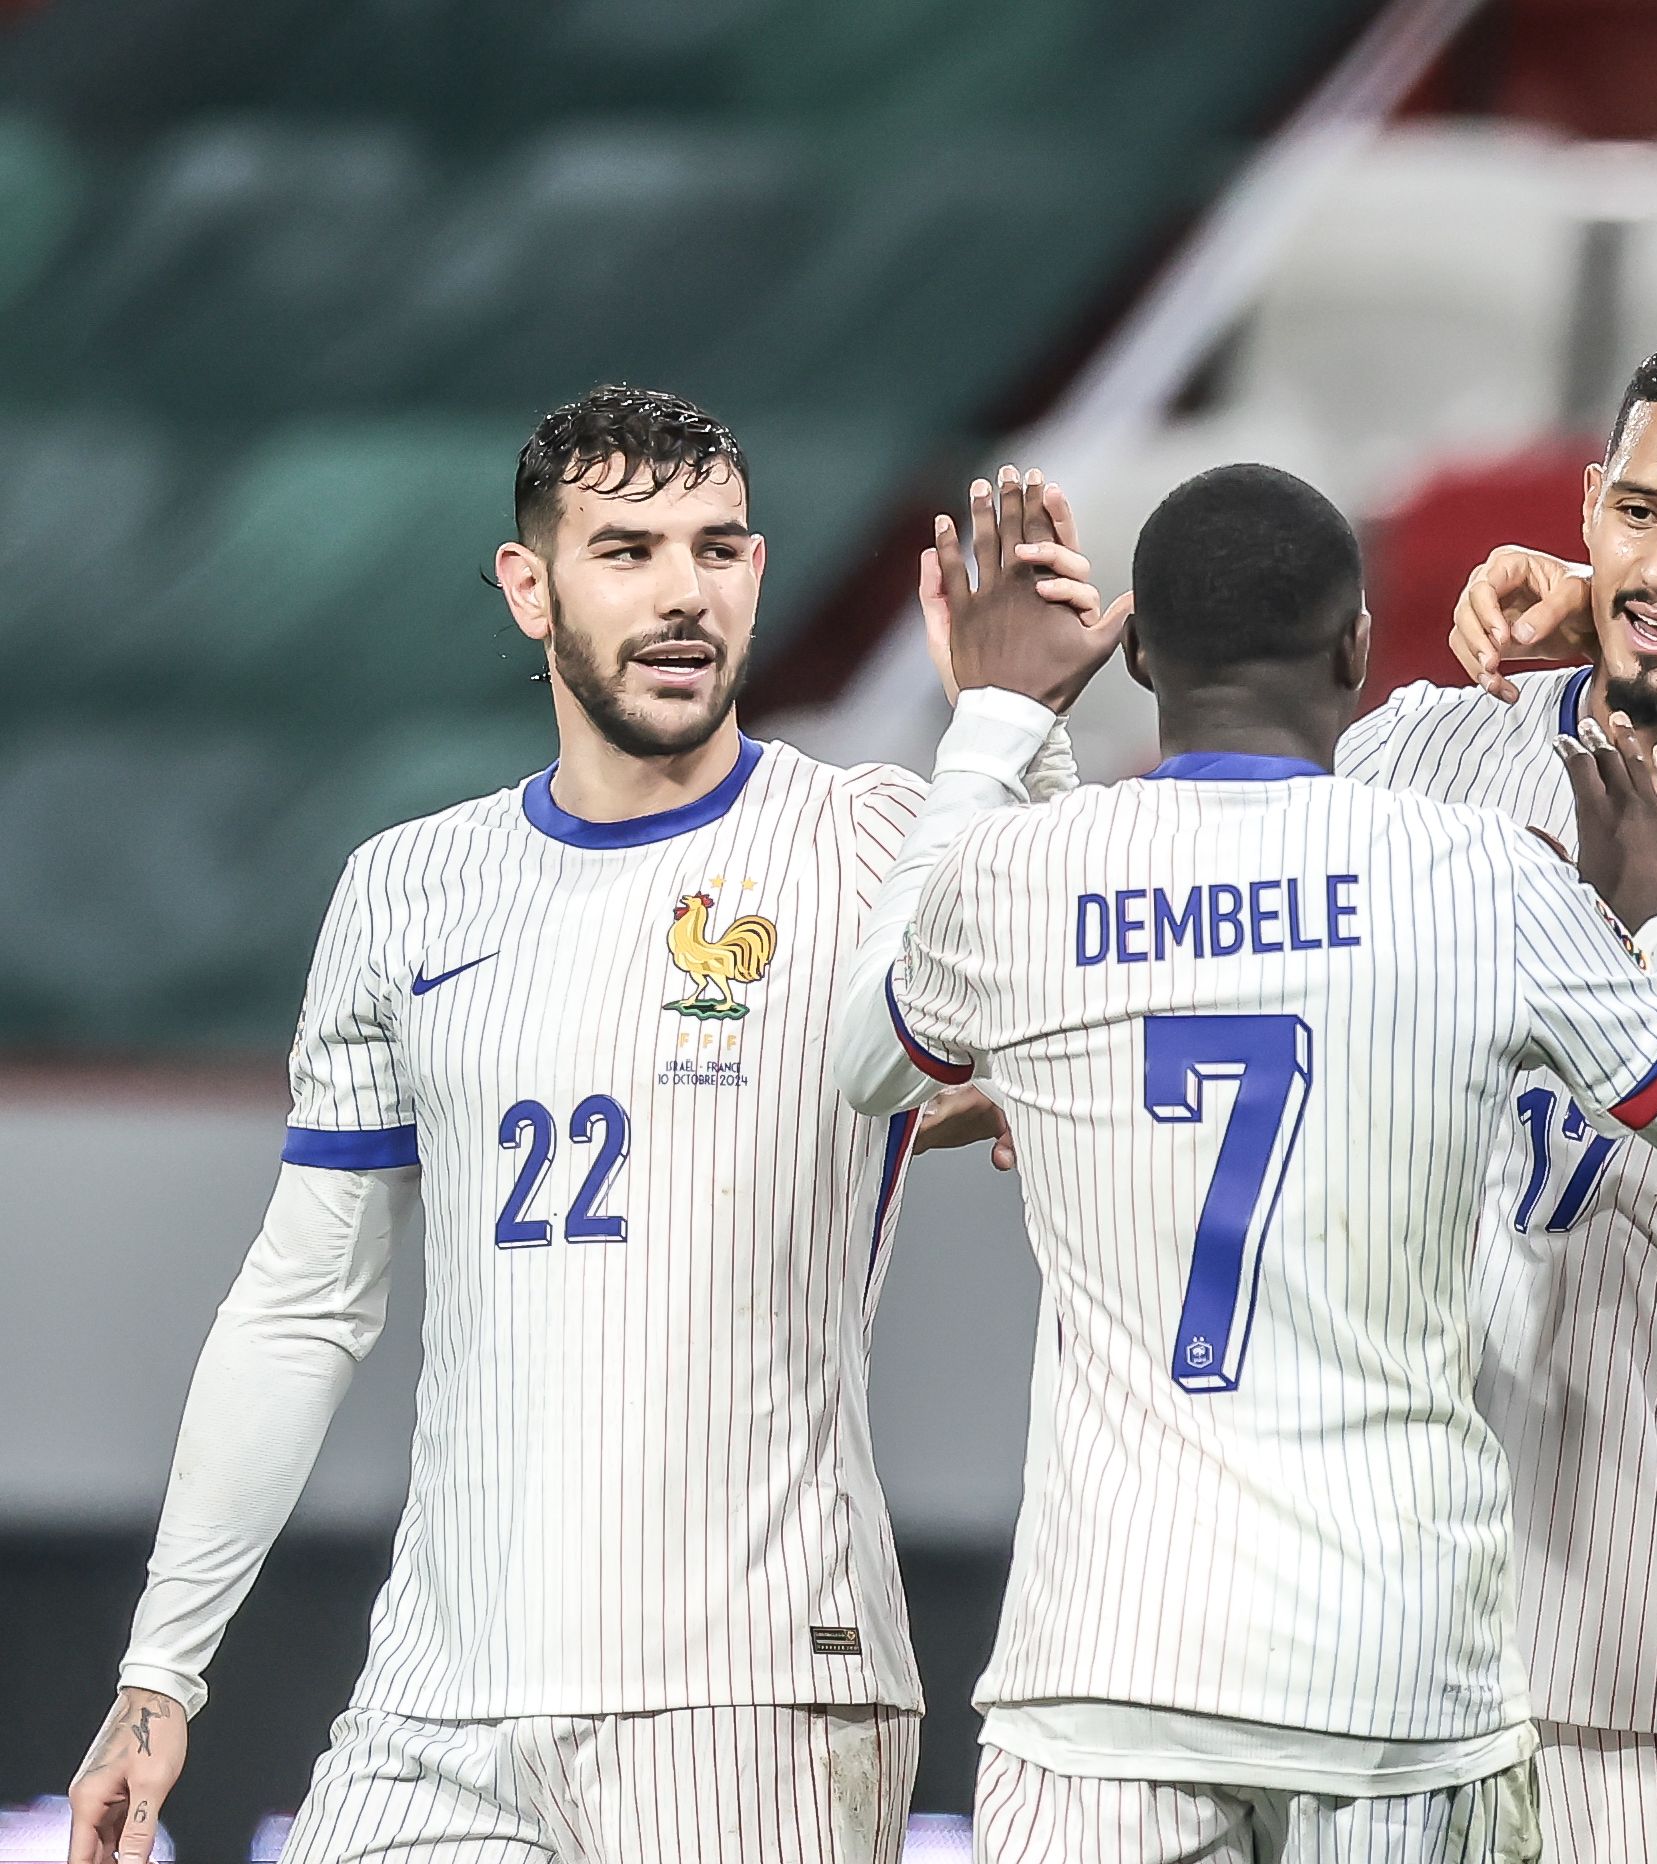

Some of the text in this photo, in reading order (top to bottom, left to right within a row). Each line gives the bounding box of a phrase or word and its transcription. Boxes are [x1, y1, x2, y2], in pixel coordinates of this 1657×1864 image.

[1076, 874, 1361, 967] DEMBELE
[658, 1073, 749, 1087] 10 OCTOBRE 2024
[495, 1094, 631, 1249] 22
[1144, 1014, 1312, 1393] 7
[1514, 1087, 1629, 1234] 17
